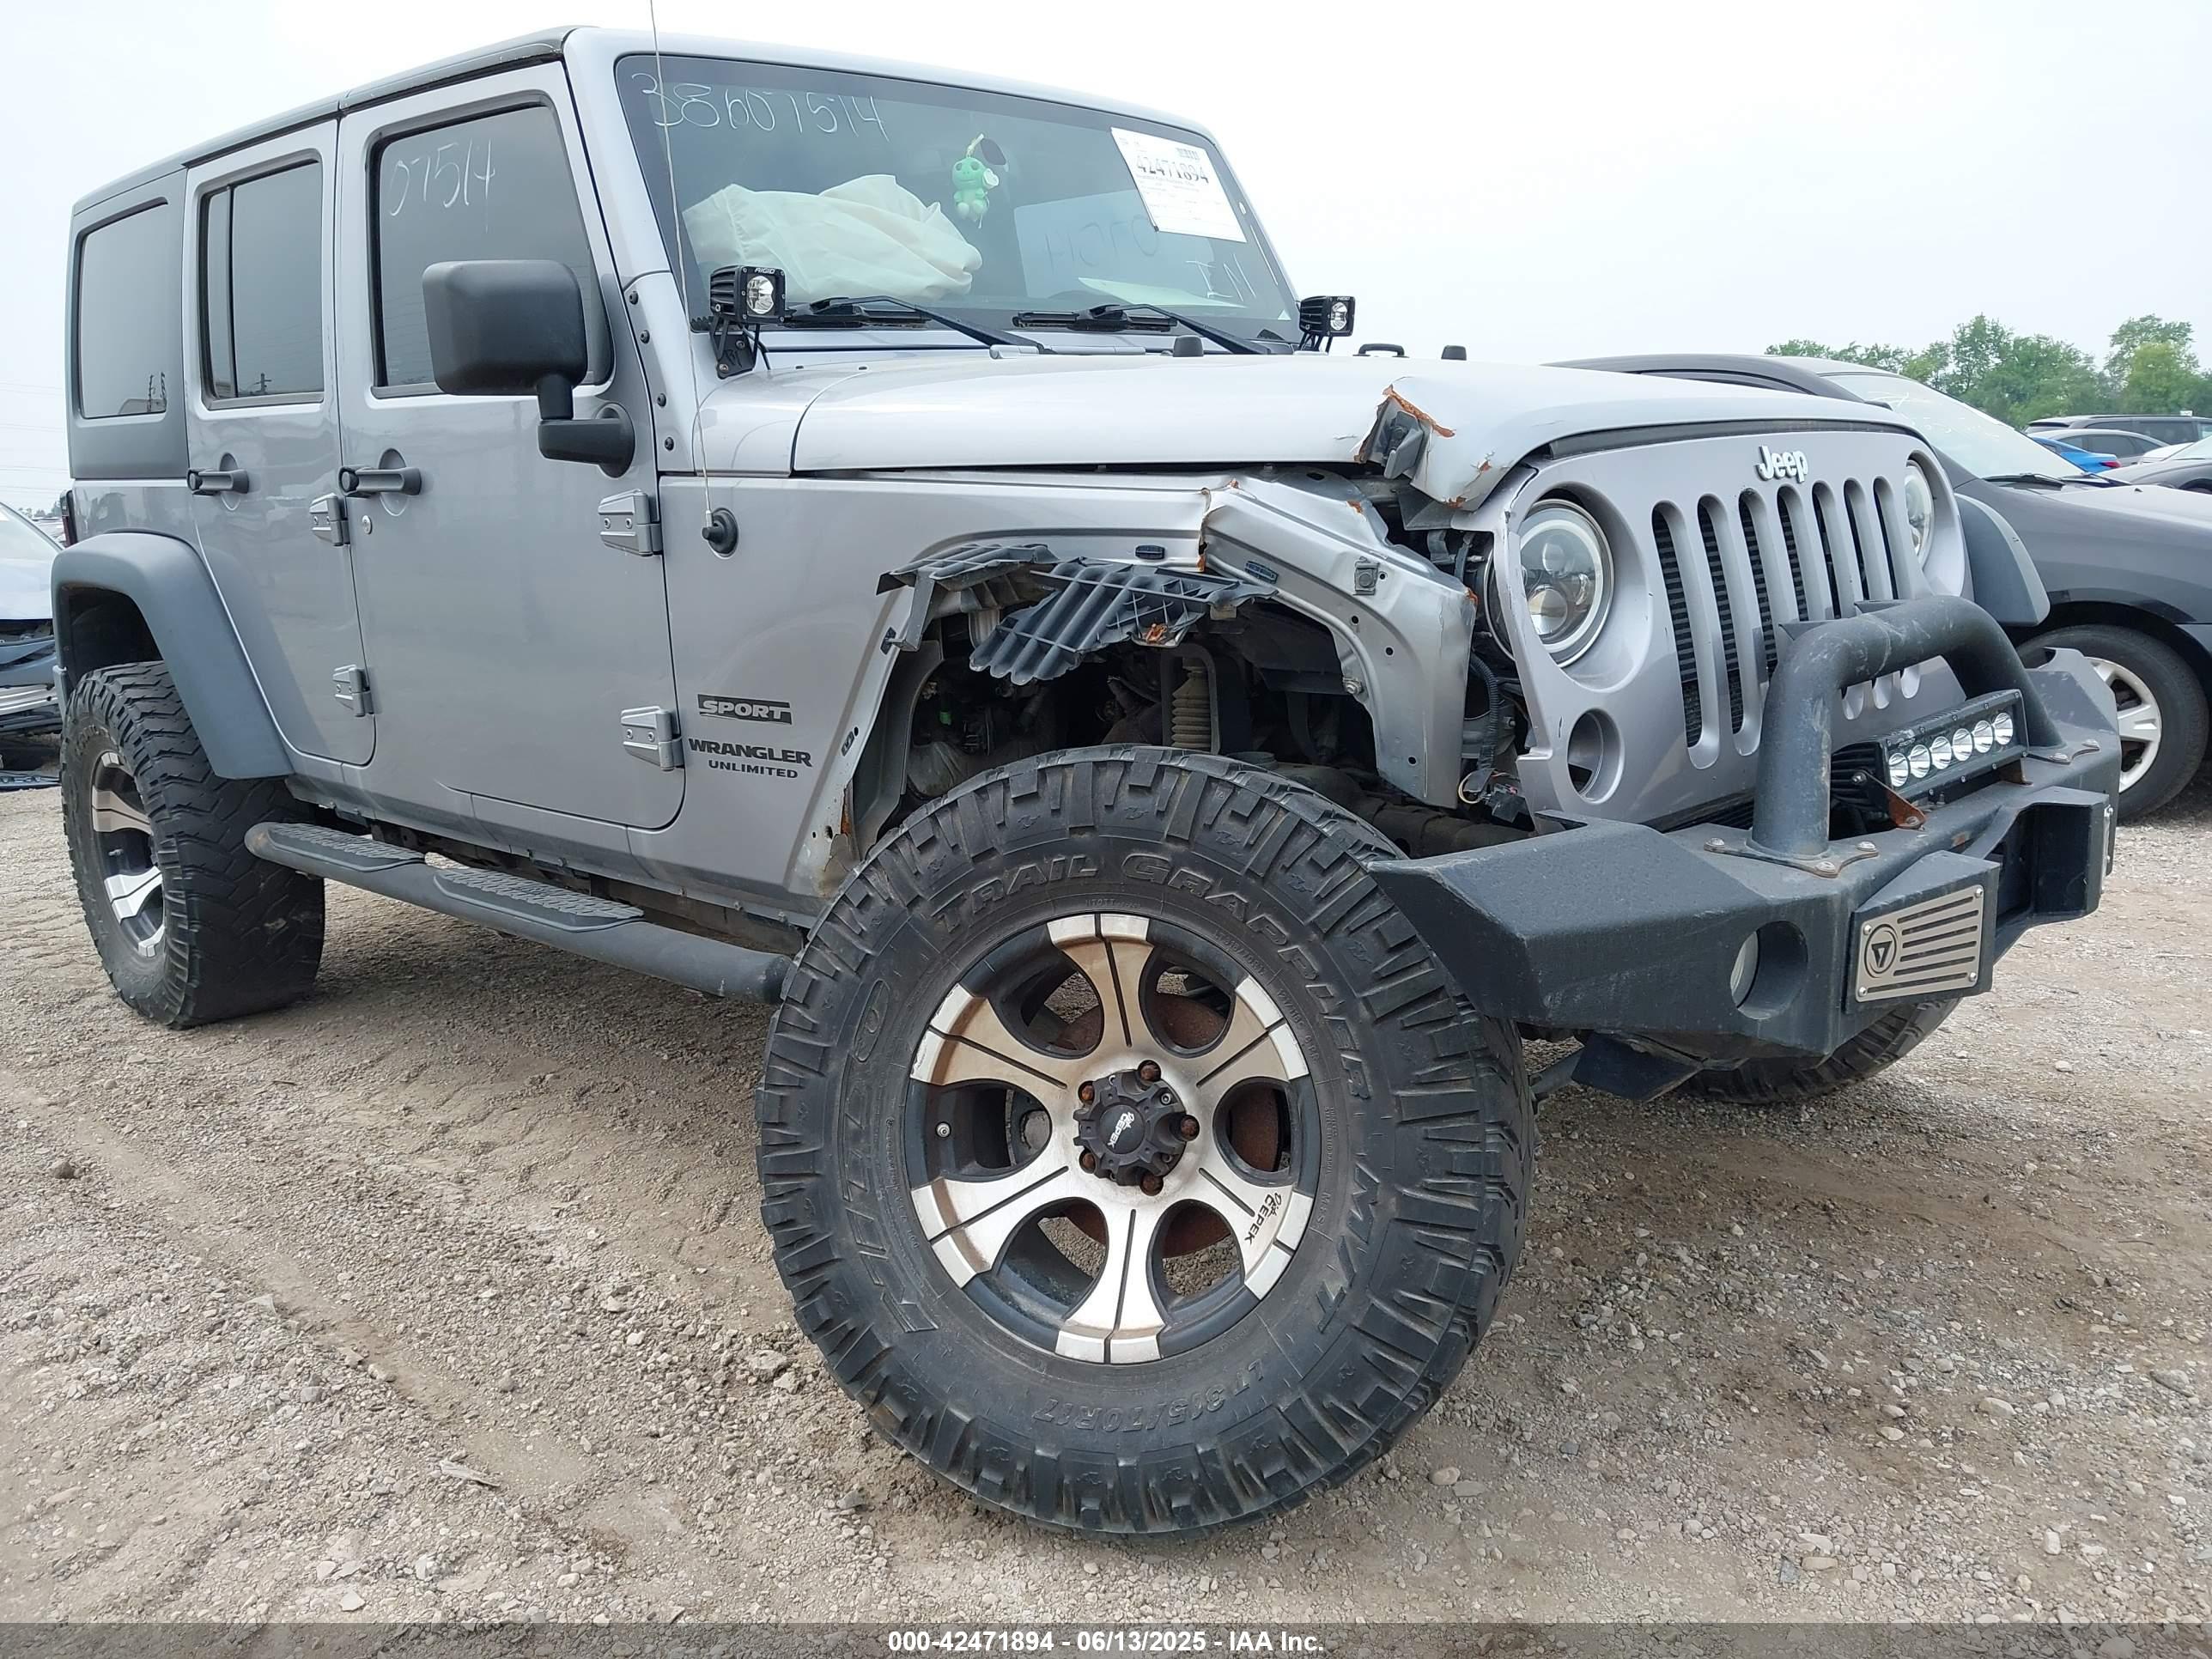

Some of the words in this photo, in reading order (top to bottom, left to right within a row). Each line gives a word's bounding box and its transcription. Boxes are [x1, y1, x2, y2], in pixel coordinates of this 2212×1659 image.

[1136, 155, 1210, 185] 42471894
[1754, 445, 1808, 483] Jeep
[701, 699, 791, 721] SPORT
[688, 738, 812, 767] WRANGLER
[708, 760, 799, 778] UNLIMITED
[930, 854, 1099, 934] TRAIL
[1121, 853, 1372, 1100] GRAPPLER
[1244, 1194, 1277, 1245] CEPEK
